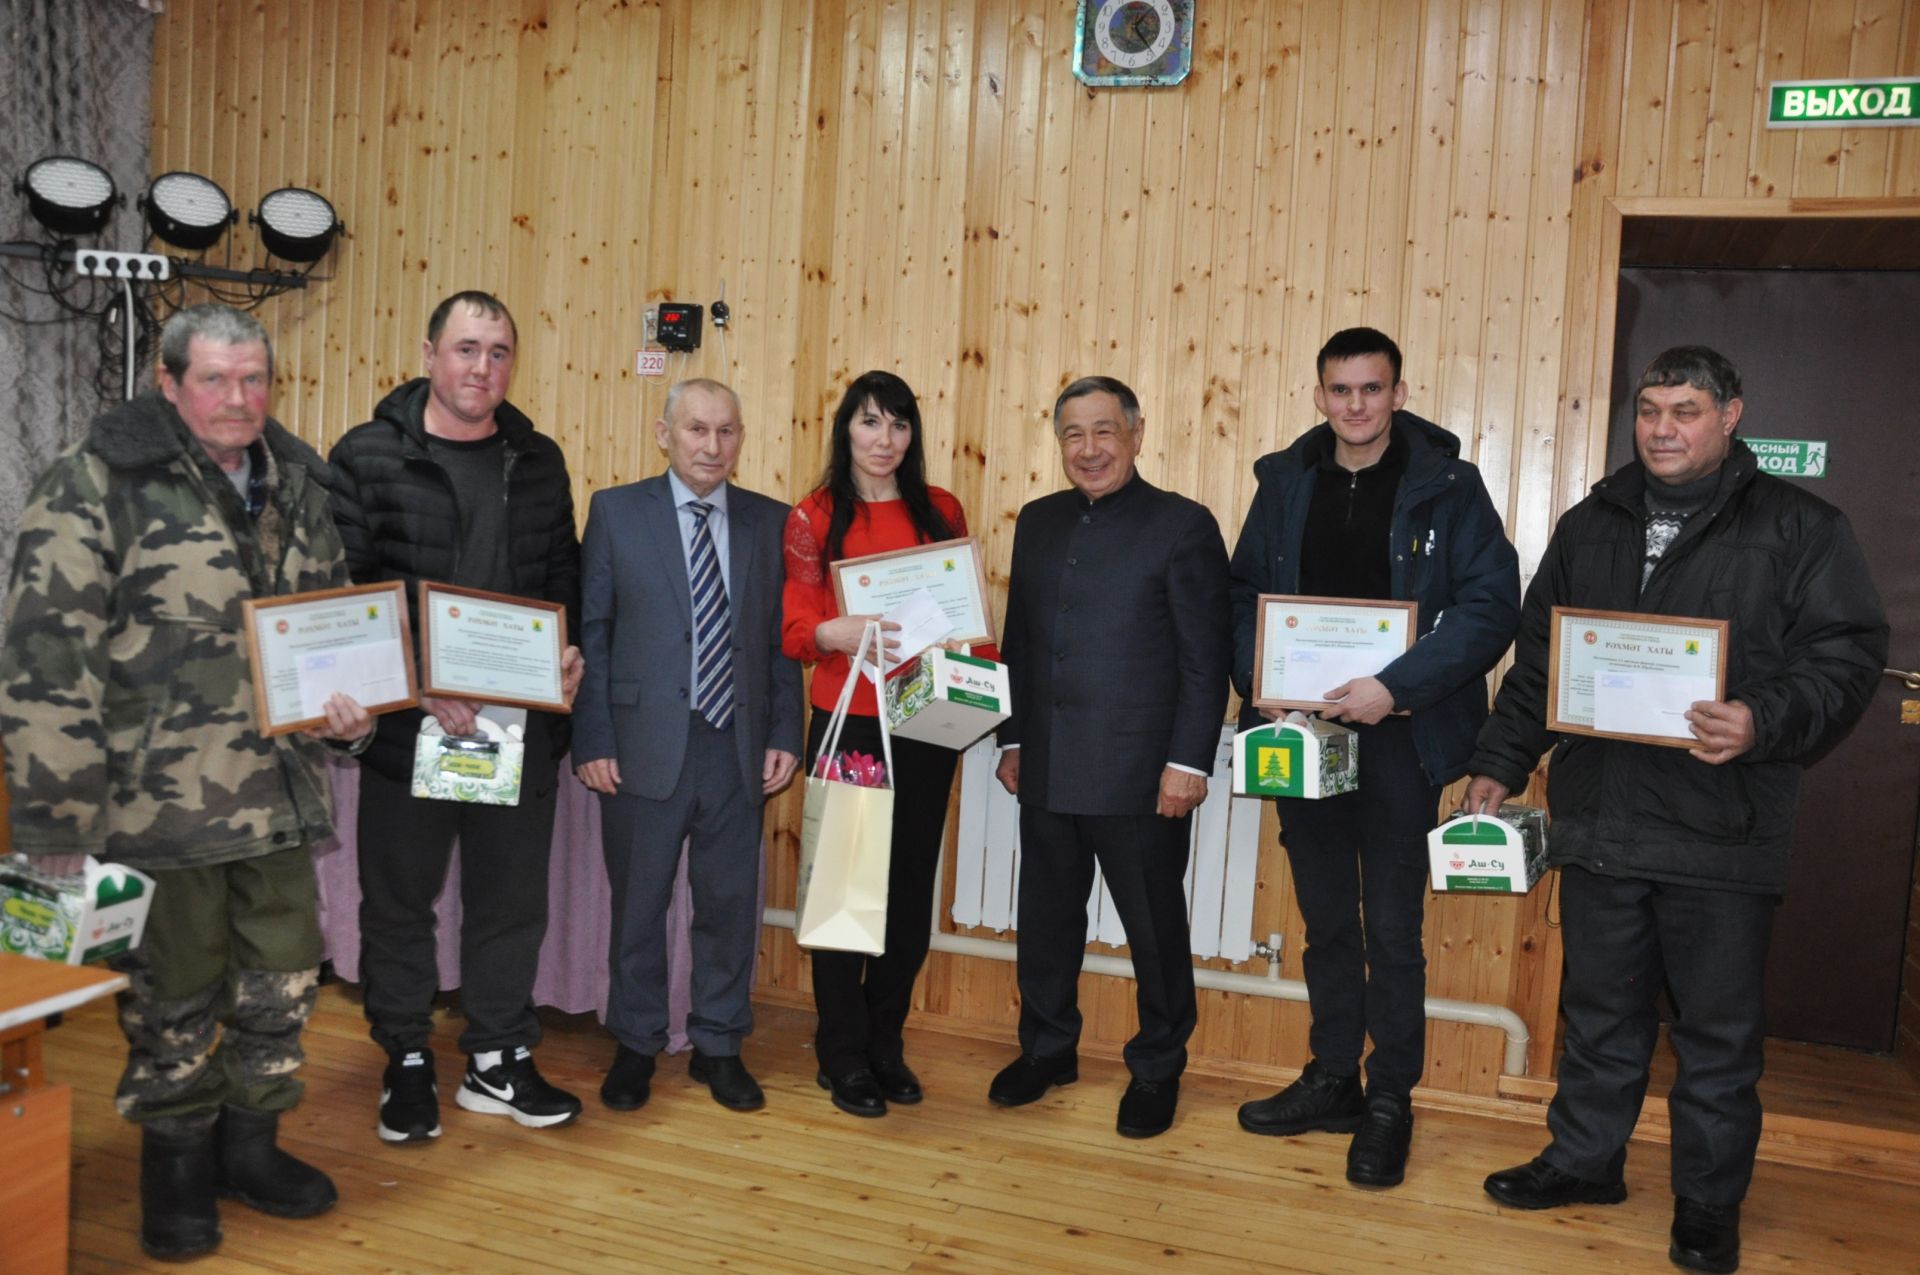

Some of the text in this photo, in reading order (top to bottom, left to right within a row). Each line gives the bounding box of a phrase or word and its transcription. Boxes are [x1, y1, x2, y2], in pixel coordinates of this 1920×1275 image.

[1161, 4, 1168, 16] 2
[1099, 22, 1105, 32] 9
[1165, 22, 1171, 33] 3
[1102, 37, 1108, 48] 8
[1159, 37, 1165, 48] 4
[1110, 51, 1116, 62] 7
[1128, 55, 1135, 66] 6
[1783, 87, 1912, 117] ВЫХОД
[642, 357, 663, 369] 220
[1747, 443, 1800, 454] АСНЫЙ
[1757, 456, 1798, 473] ХОД
